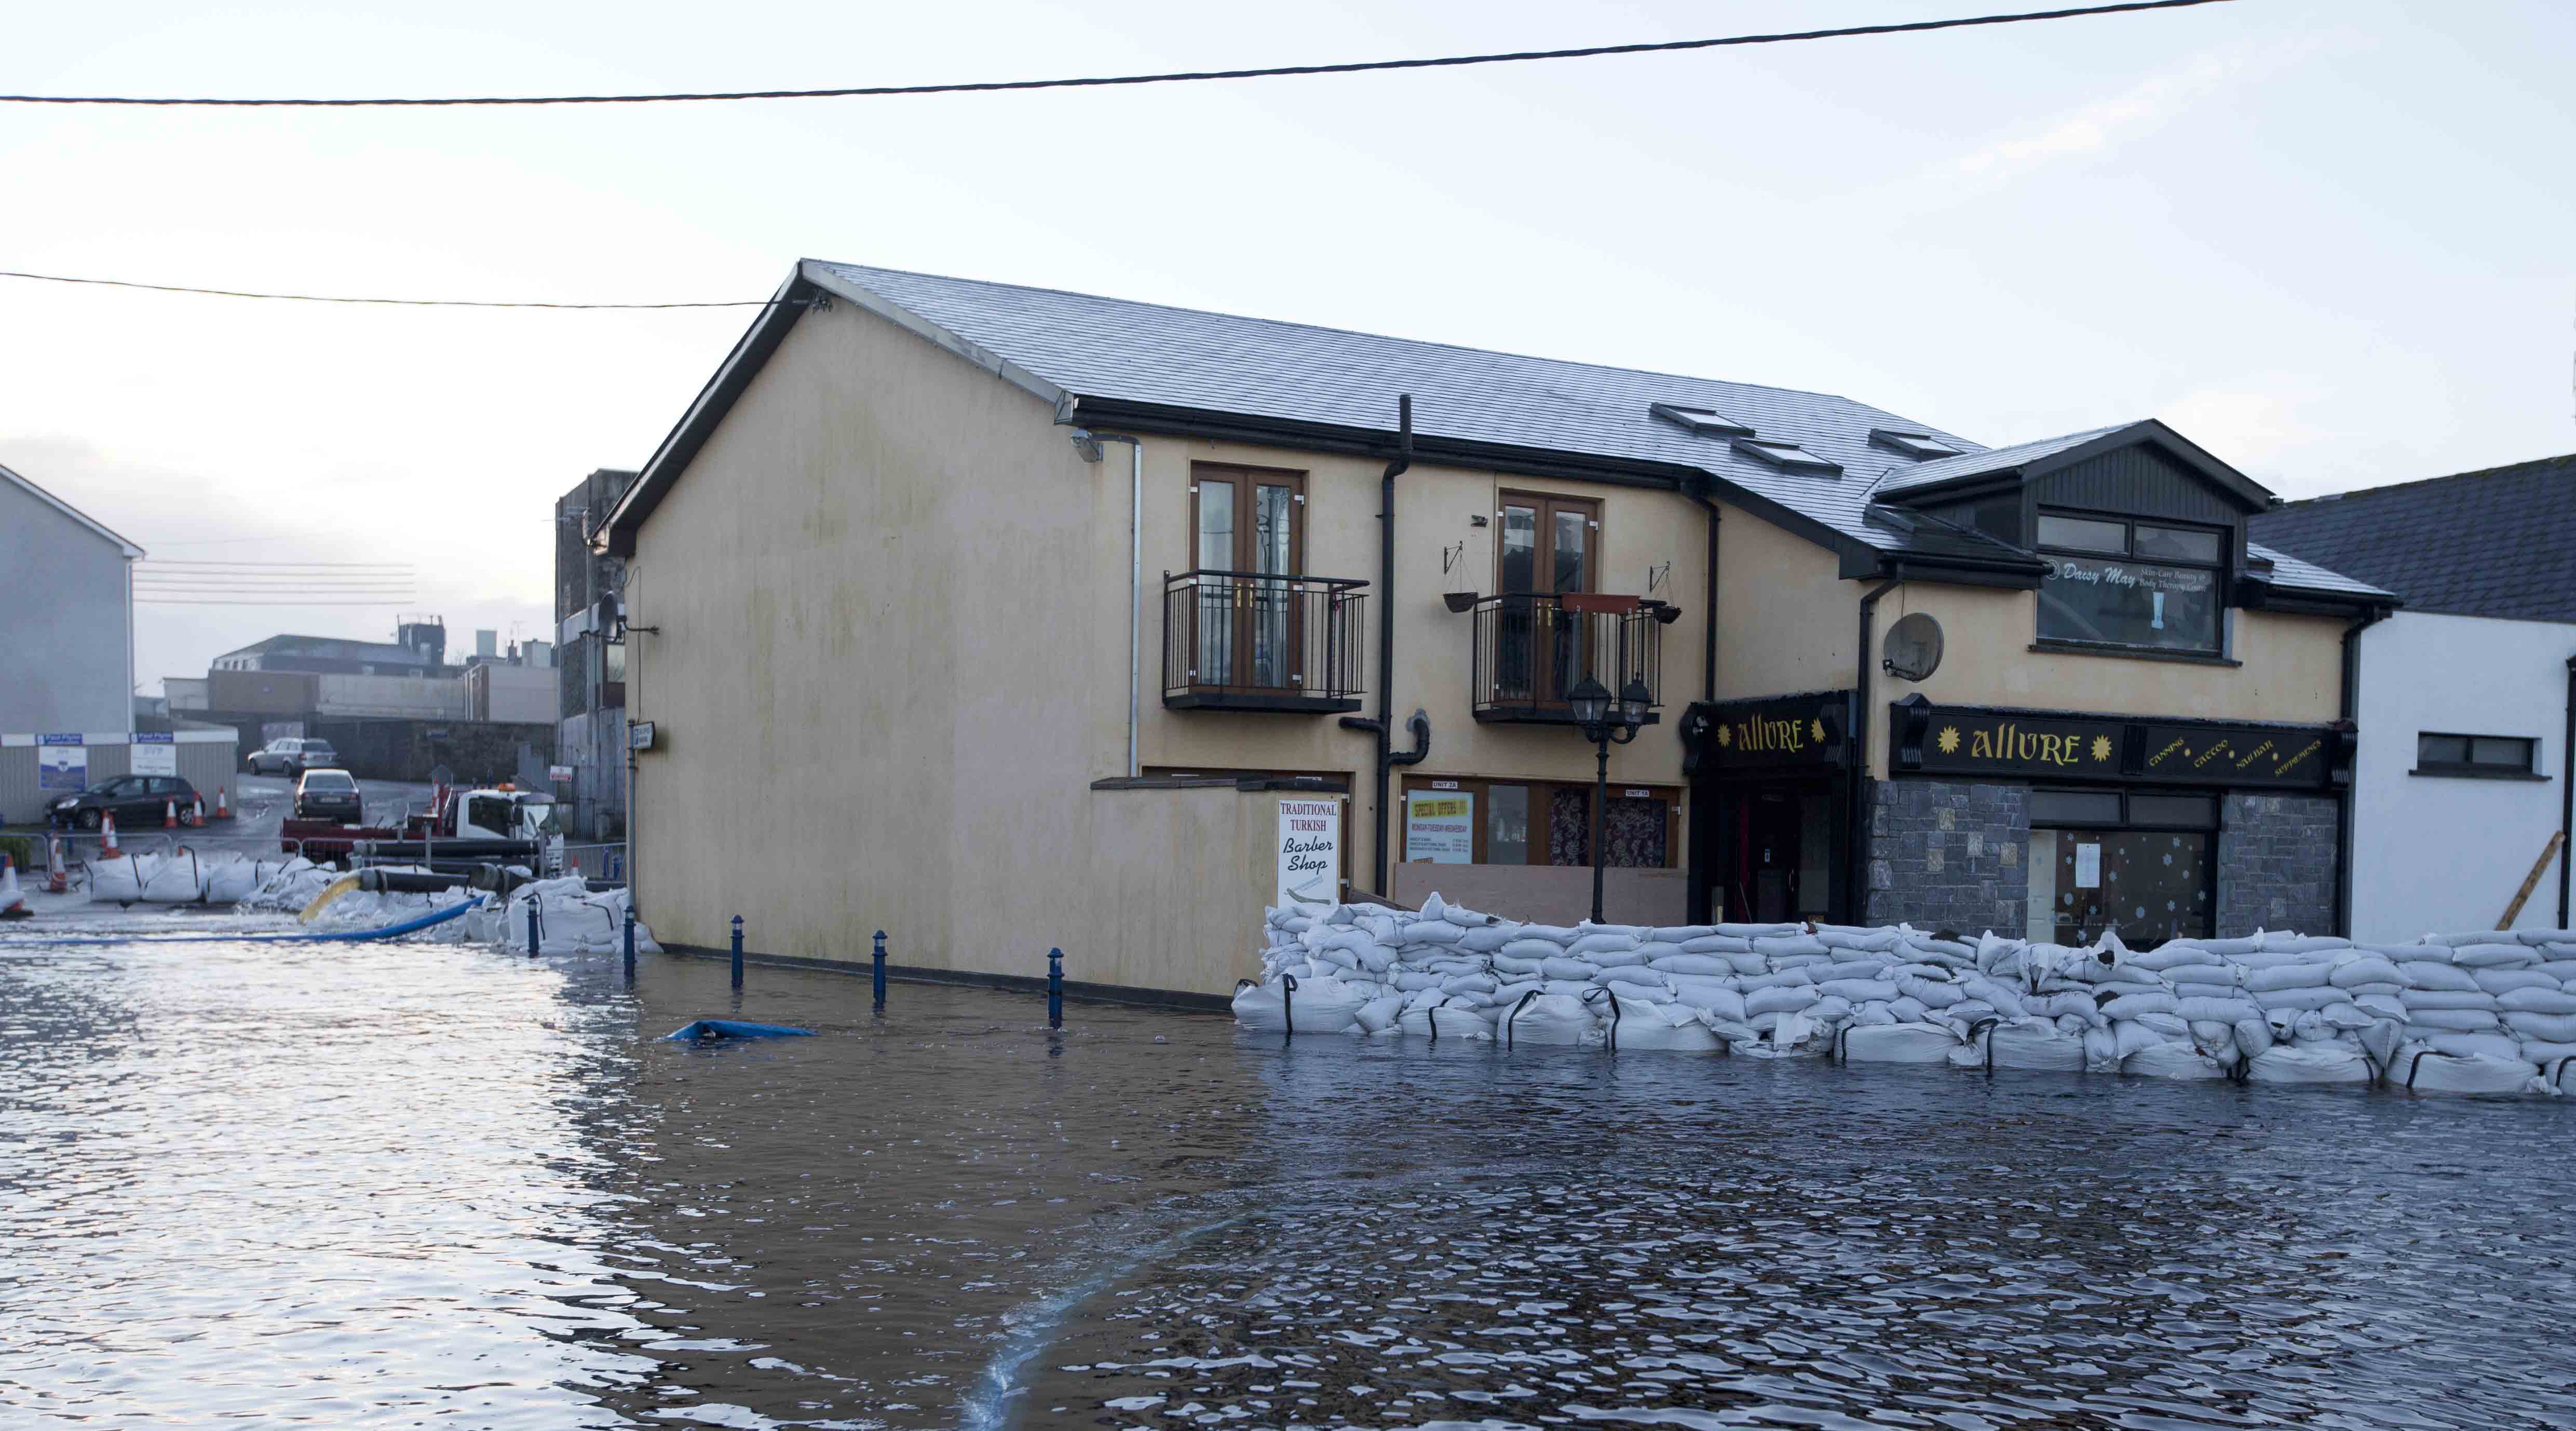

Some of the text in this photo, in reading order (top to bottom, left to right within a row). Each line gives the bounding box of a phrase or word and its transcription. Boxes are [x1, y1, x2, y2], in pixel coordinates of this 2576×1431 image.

[2064, 562, 2135, 588] Daisy May
[2139, 578, 2156, 591] Body
[2148, 737, 2185, 767] TANNING
[2193, 739, 2229, 768] TATTOO
[1280, 803, 1337, 815] TRADITIONAL
[1415, 802, 1436, 817] SPECIAL
[1437, 801, 1456, 815] OFFERS
[1290, 820, 1326, 831] TURKISH
[1283, 836, 1333, 853] Barber
[1287, 854, 1327, 875] Shop
